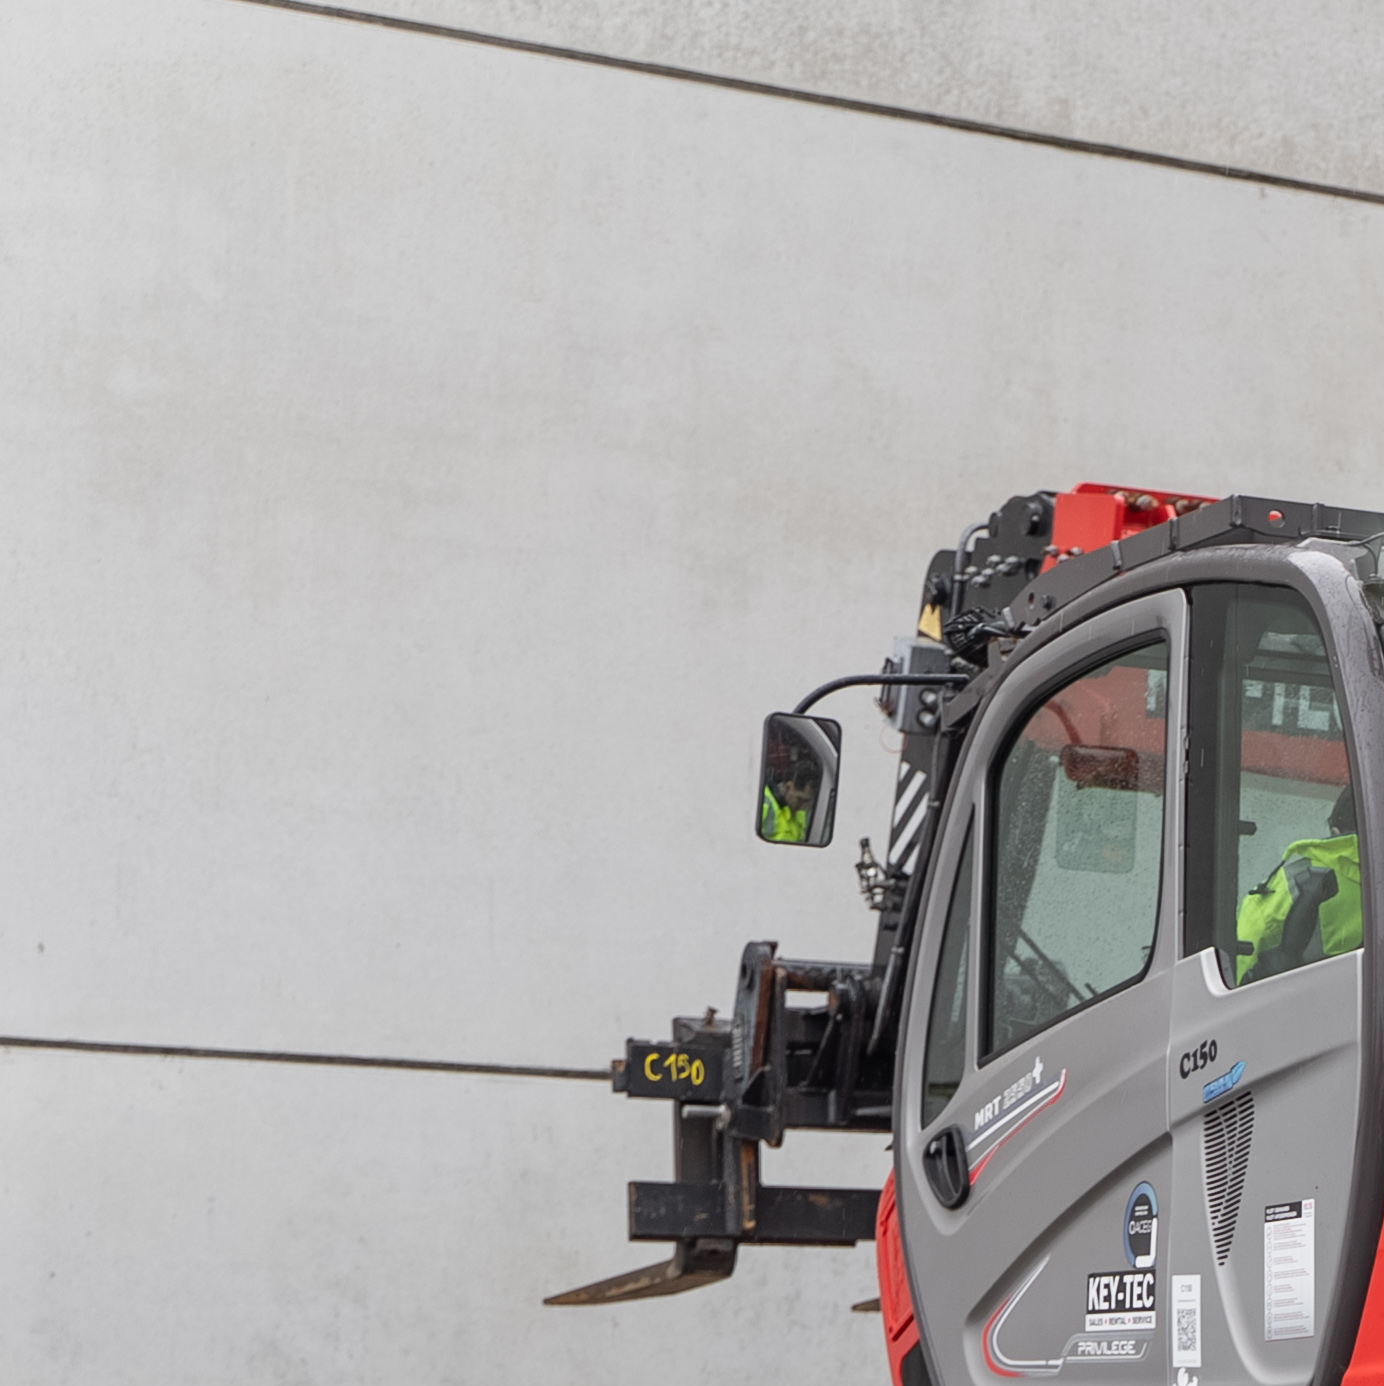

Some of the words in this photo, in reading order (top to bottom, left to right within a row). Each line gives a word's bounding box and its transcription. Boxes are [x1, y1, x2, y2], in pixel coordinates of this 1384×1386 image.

[1180, 1039, 1217, 1079] C150
[975, 1095, 1001, 1130] MRT
[1088, 1273, 1154, 1310] KEY-TEC
[1089, 1317, 1103, 1326] SALES
[1132, 1316, 1152, 1324] SERVICE
[1077, 1341, 1136, 1355] PRIVILEGE
